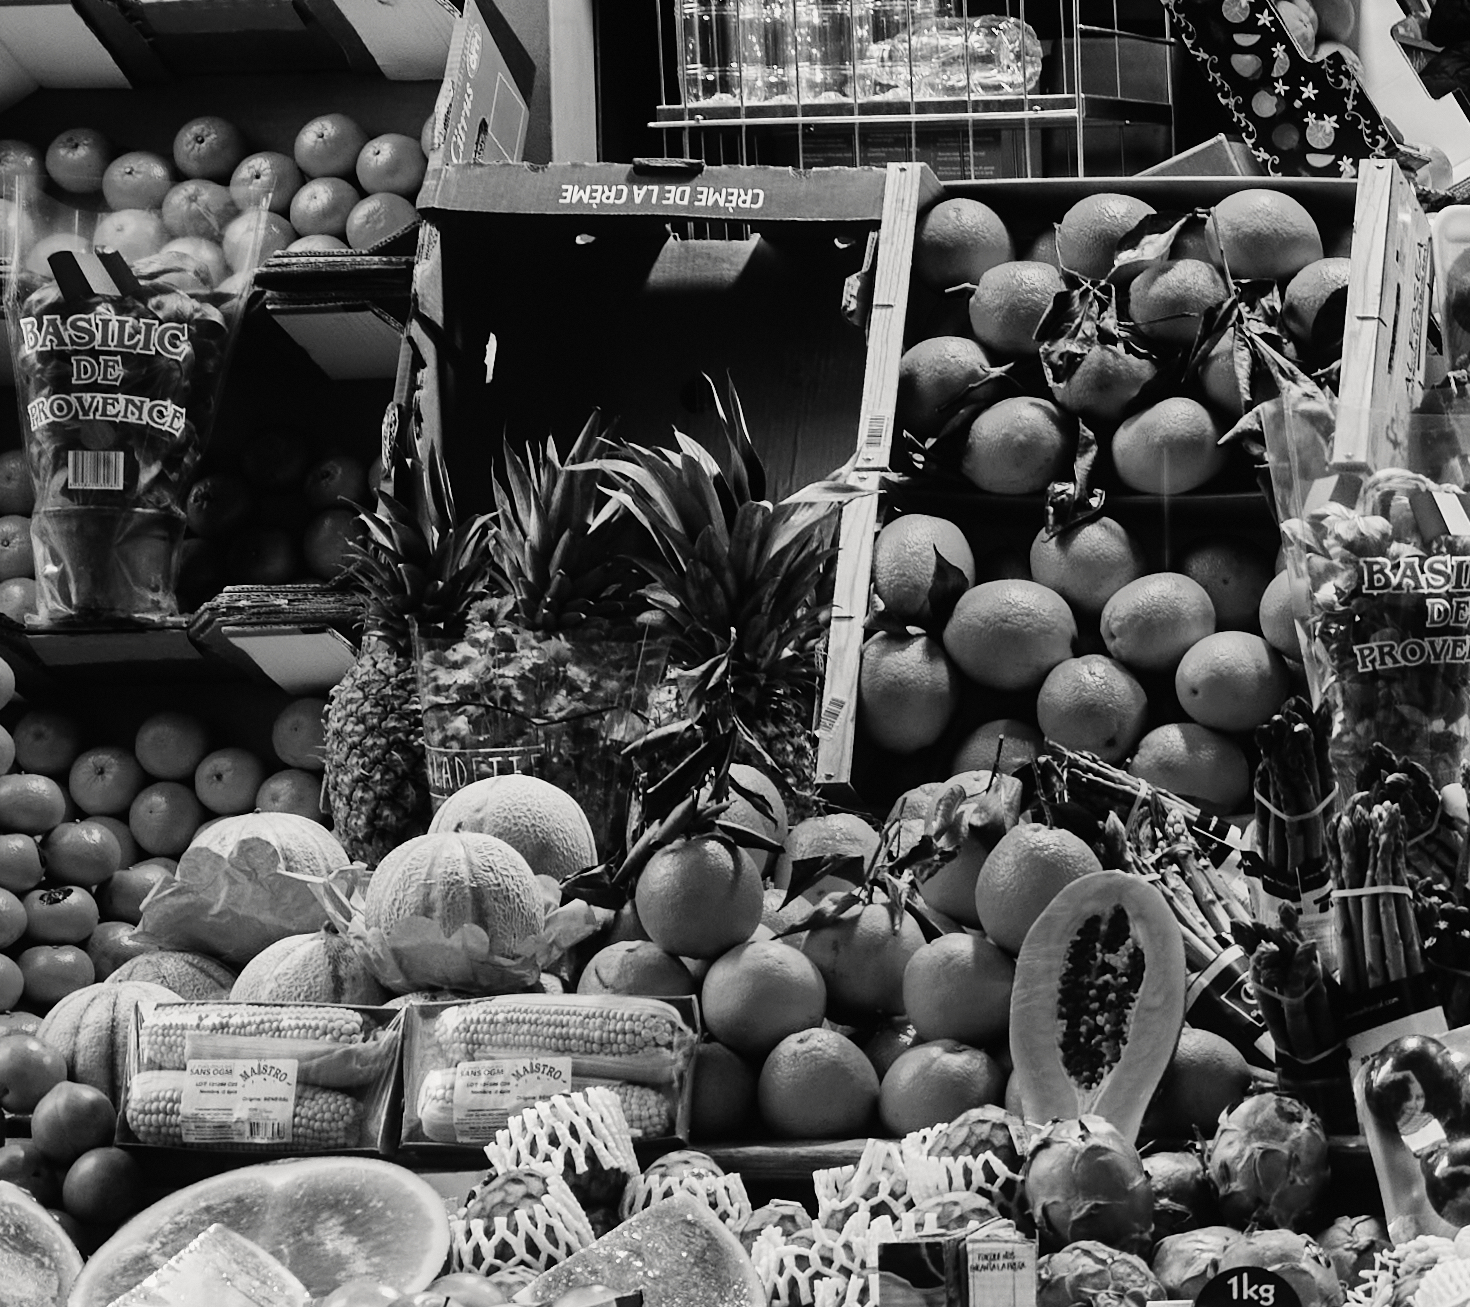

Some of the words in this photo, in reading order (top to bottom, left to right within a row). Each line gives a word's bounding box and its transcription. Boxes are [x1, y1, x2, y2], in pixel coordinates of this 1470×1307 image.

[557, 183, 630, 209] CRÈME
[632, 184, 660, 205] LA
[660, 184, 692, 207] DE
[693, 185, 766, 213] CRÈME
[19, 313, 191, 361] BASILIC
[70, 355, 126, 387] DE
[26, 392, 188, 437] PROVENCE
[1425, 598, 1470, 630] DE
[1226, 1271, 1276, 1307] 1kg
